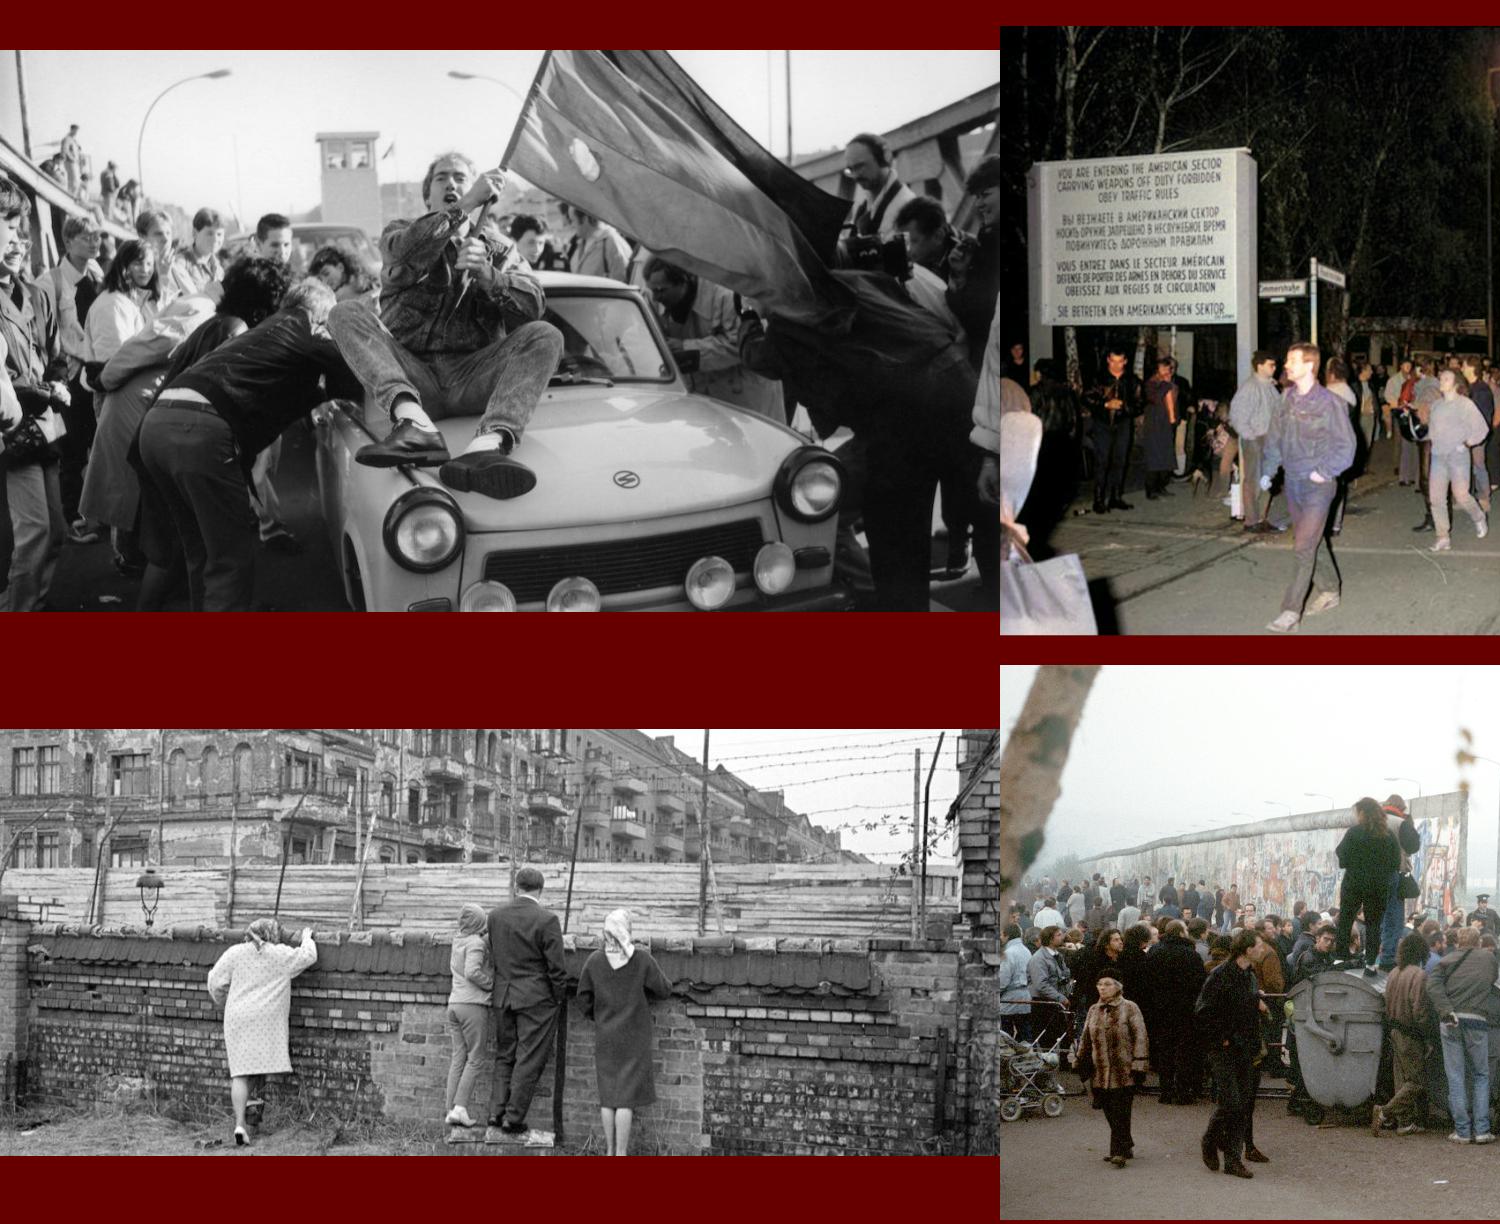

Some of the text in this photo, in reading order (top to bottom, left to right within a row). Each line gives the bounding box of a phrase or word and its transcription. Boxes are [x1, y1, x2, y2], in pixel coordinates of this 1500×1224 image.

[1058, 157, 1222, 179] YOU ARE ENTERING THE AMERICAN SECTOR
[1057, 171, 1221, 192] CARRYING WEAPONS OFF DUTY FORBIDDEN
[1098, 187, 1179, 203] OBEY TRAFFIC RULES
[1191, 206, 1219, 219] СЕКТОР
[1203, 219, 1226, 232] ВРЕМЯ
[1170, 234, 1213, 247] ПРАВИЛАМ
[1056, 260, 1076, 272] VOUS
[1080, 259, 1106, 271] ENTREZ
[1110, 258, 1130, 270] DANS
[1133, 258, 1140, 269] LE
[1144, 256, 1177, 269] SECTEUR
[1083, 272, 1091, 283] DE
[1092, 271, 1113, 283] PORTER
[1115, 270, 1127, 282] DES
[1129, 269, 1148, 282] ARMES
[1150, 270, 1159, 281] EN
[1161, 269, 1186, 280] DEHORS
[1188, 269, 1197, 280] DU
[1200, 267, 1226, 280] SERVICE
[1105, 285, 1119, 295] AUX
[1153, 283, 1162, 293] DE
[1167, 282, 1215, 293] CIRCULATION
[1058, 302, 1224, 318] SIE BETRETEN DEN AMERIKANISCHEN SEKTOR
